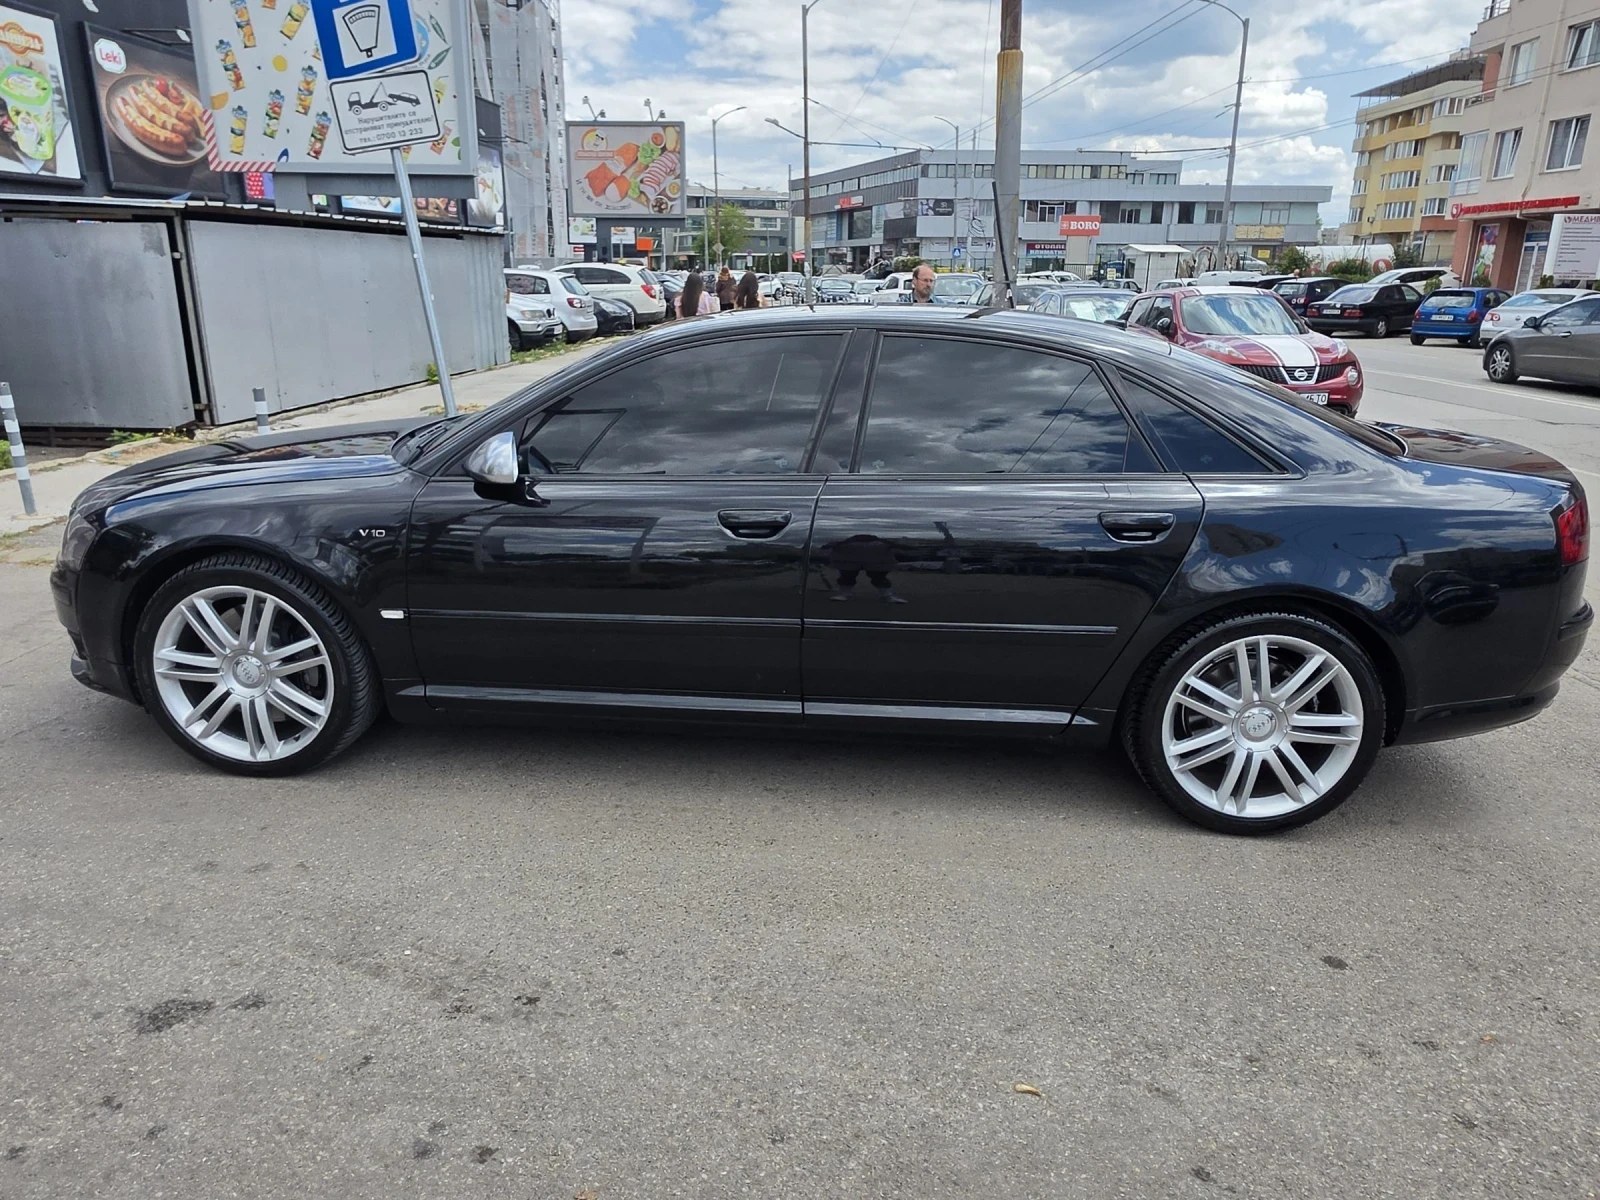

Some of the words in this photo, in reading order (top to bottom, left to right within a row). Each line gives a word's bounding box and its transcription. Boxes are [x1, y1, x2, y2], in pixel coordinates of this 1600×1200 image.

[99, 48, 121, 64] Leki
[376, 131, 396, 140] 0700
[1069, 221, 1100, 230] BORO
